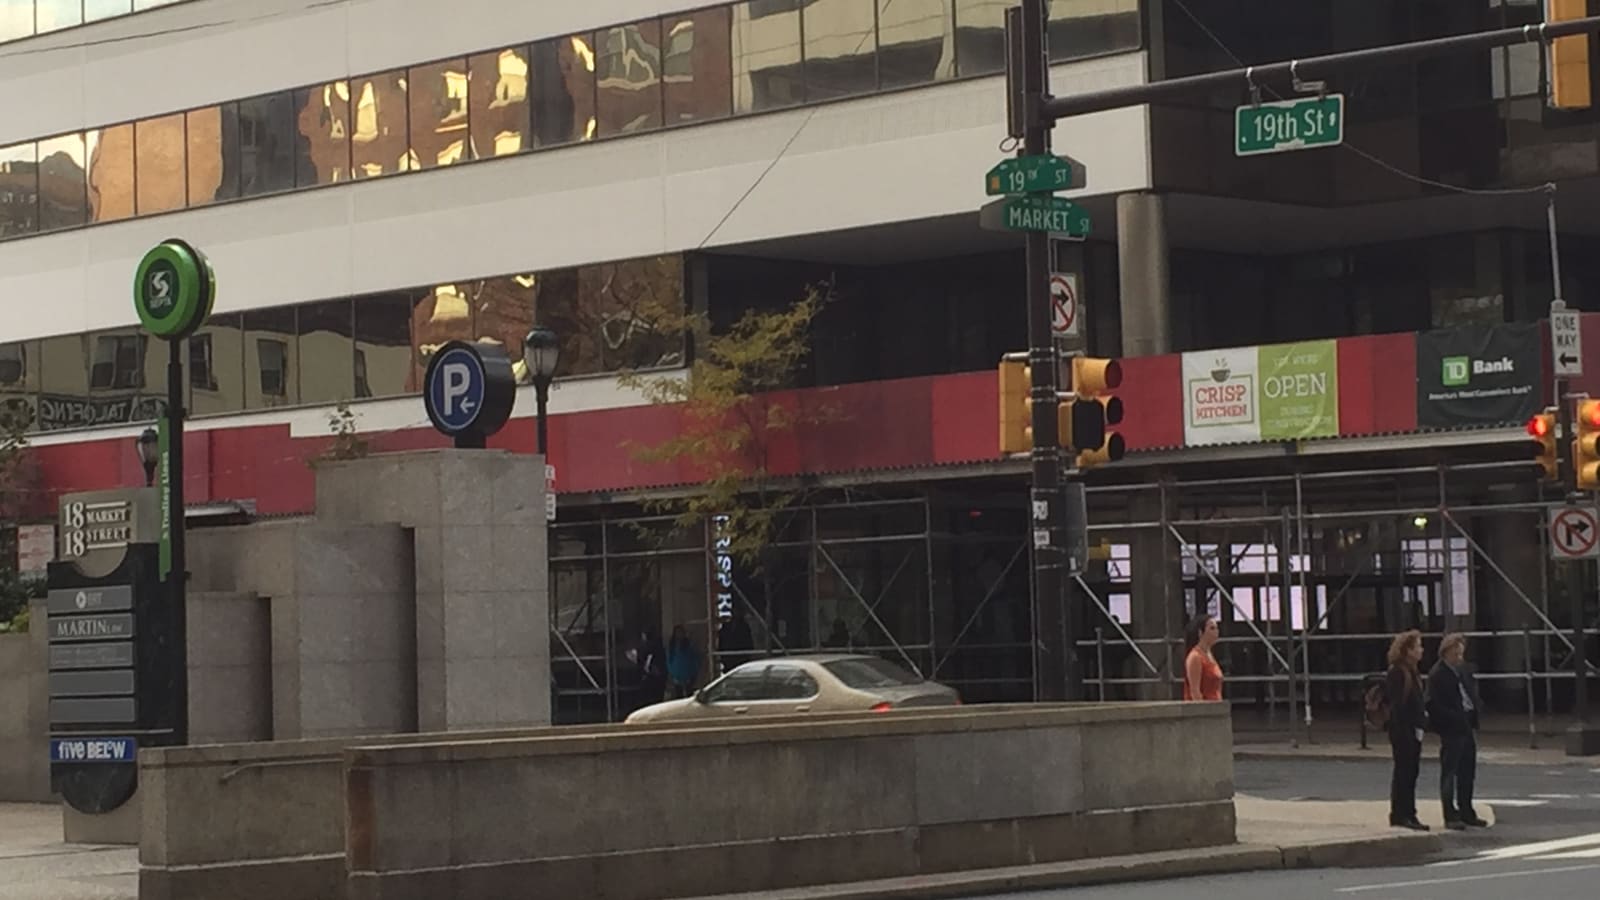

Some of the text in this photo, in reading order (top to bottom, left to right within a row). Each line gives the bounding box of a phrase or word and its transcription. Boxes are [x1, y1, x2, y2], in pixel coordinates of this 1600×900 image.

[1254, 109, 1324, 141] 19th St
[1009, 170, 1025, 191] 19
[1055, 169, 1067, 184] ST
[1009, 206, 1090, 233] MARKET ST
[1555, 315, 1577, 331] ONE
[1556, 334, 1577, 348] WAY
[1446, 357, 1514, 380] TD Bank
[443, 363, 471, 416] P
[1195, 384, 1247, 405] CRISP
[1264, 372, 1327, 399] OPEN
[1196, 404, 1247, 420] KITCHEN
[64, 502, 127, 529] 18 MARKET
[65, 530, 85, 557] 18
[86, 527, 127, 542] STREET
[57, 620, 107, 636] MARTIN
[58, 740, 126, 759] five BELOW
